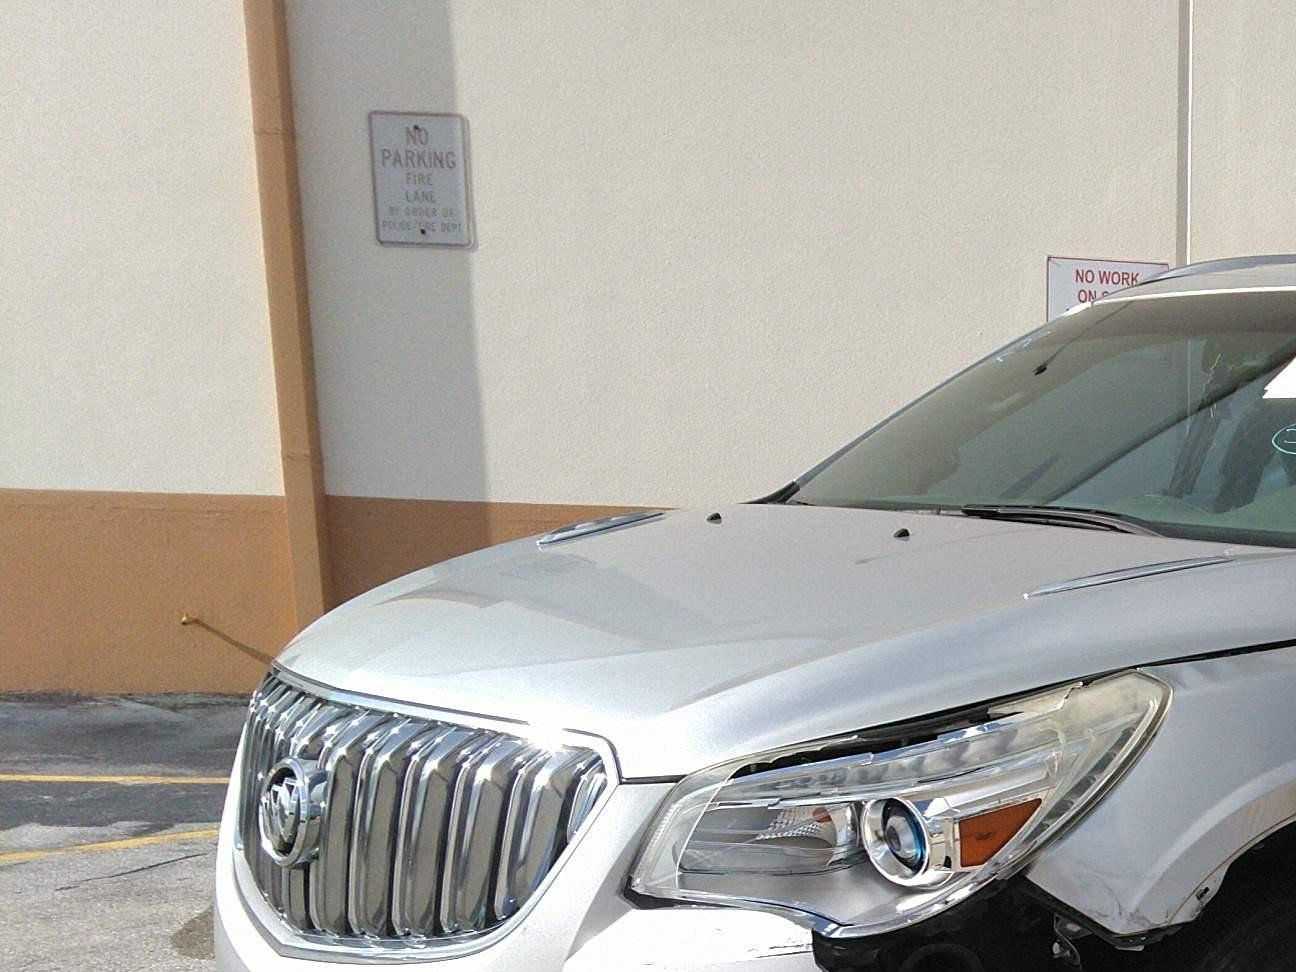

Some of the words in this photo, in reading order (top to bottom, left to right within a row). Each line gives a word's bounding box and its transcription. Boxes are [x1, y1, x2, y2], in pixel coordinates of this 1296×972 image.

[405, 127, 429, 145] NO
[381, 149, 457, 169] PARKING
[405, 173, 433, 186] FIRE
[405, 190, 436, 203] LANE
[1075, 269, 1095, 283] NO
[1098, 270, 1140, 286] WORK
[1078, 289, 1097, 303] ON
